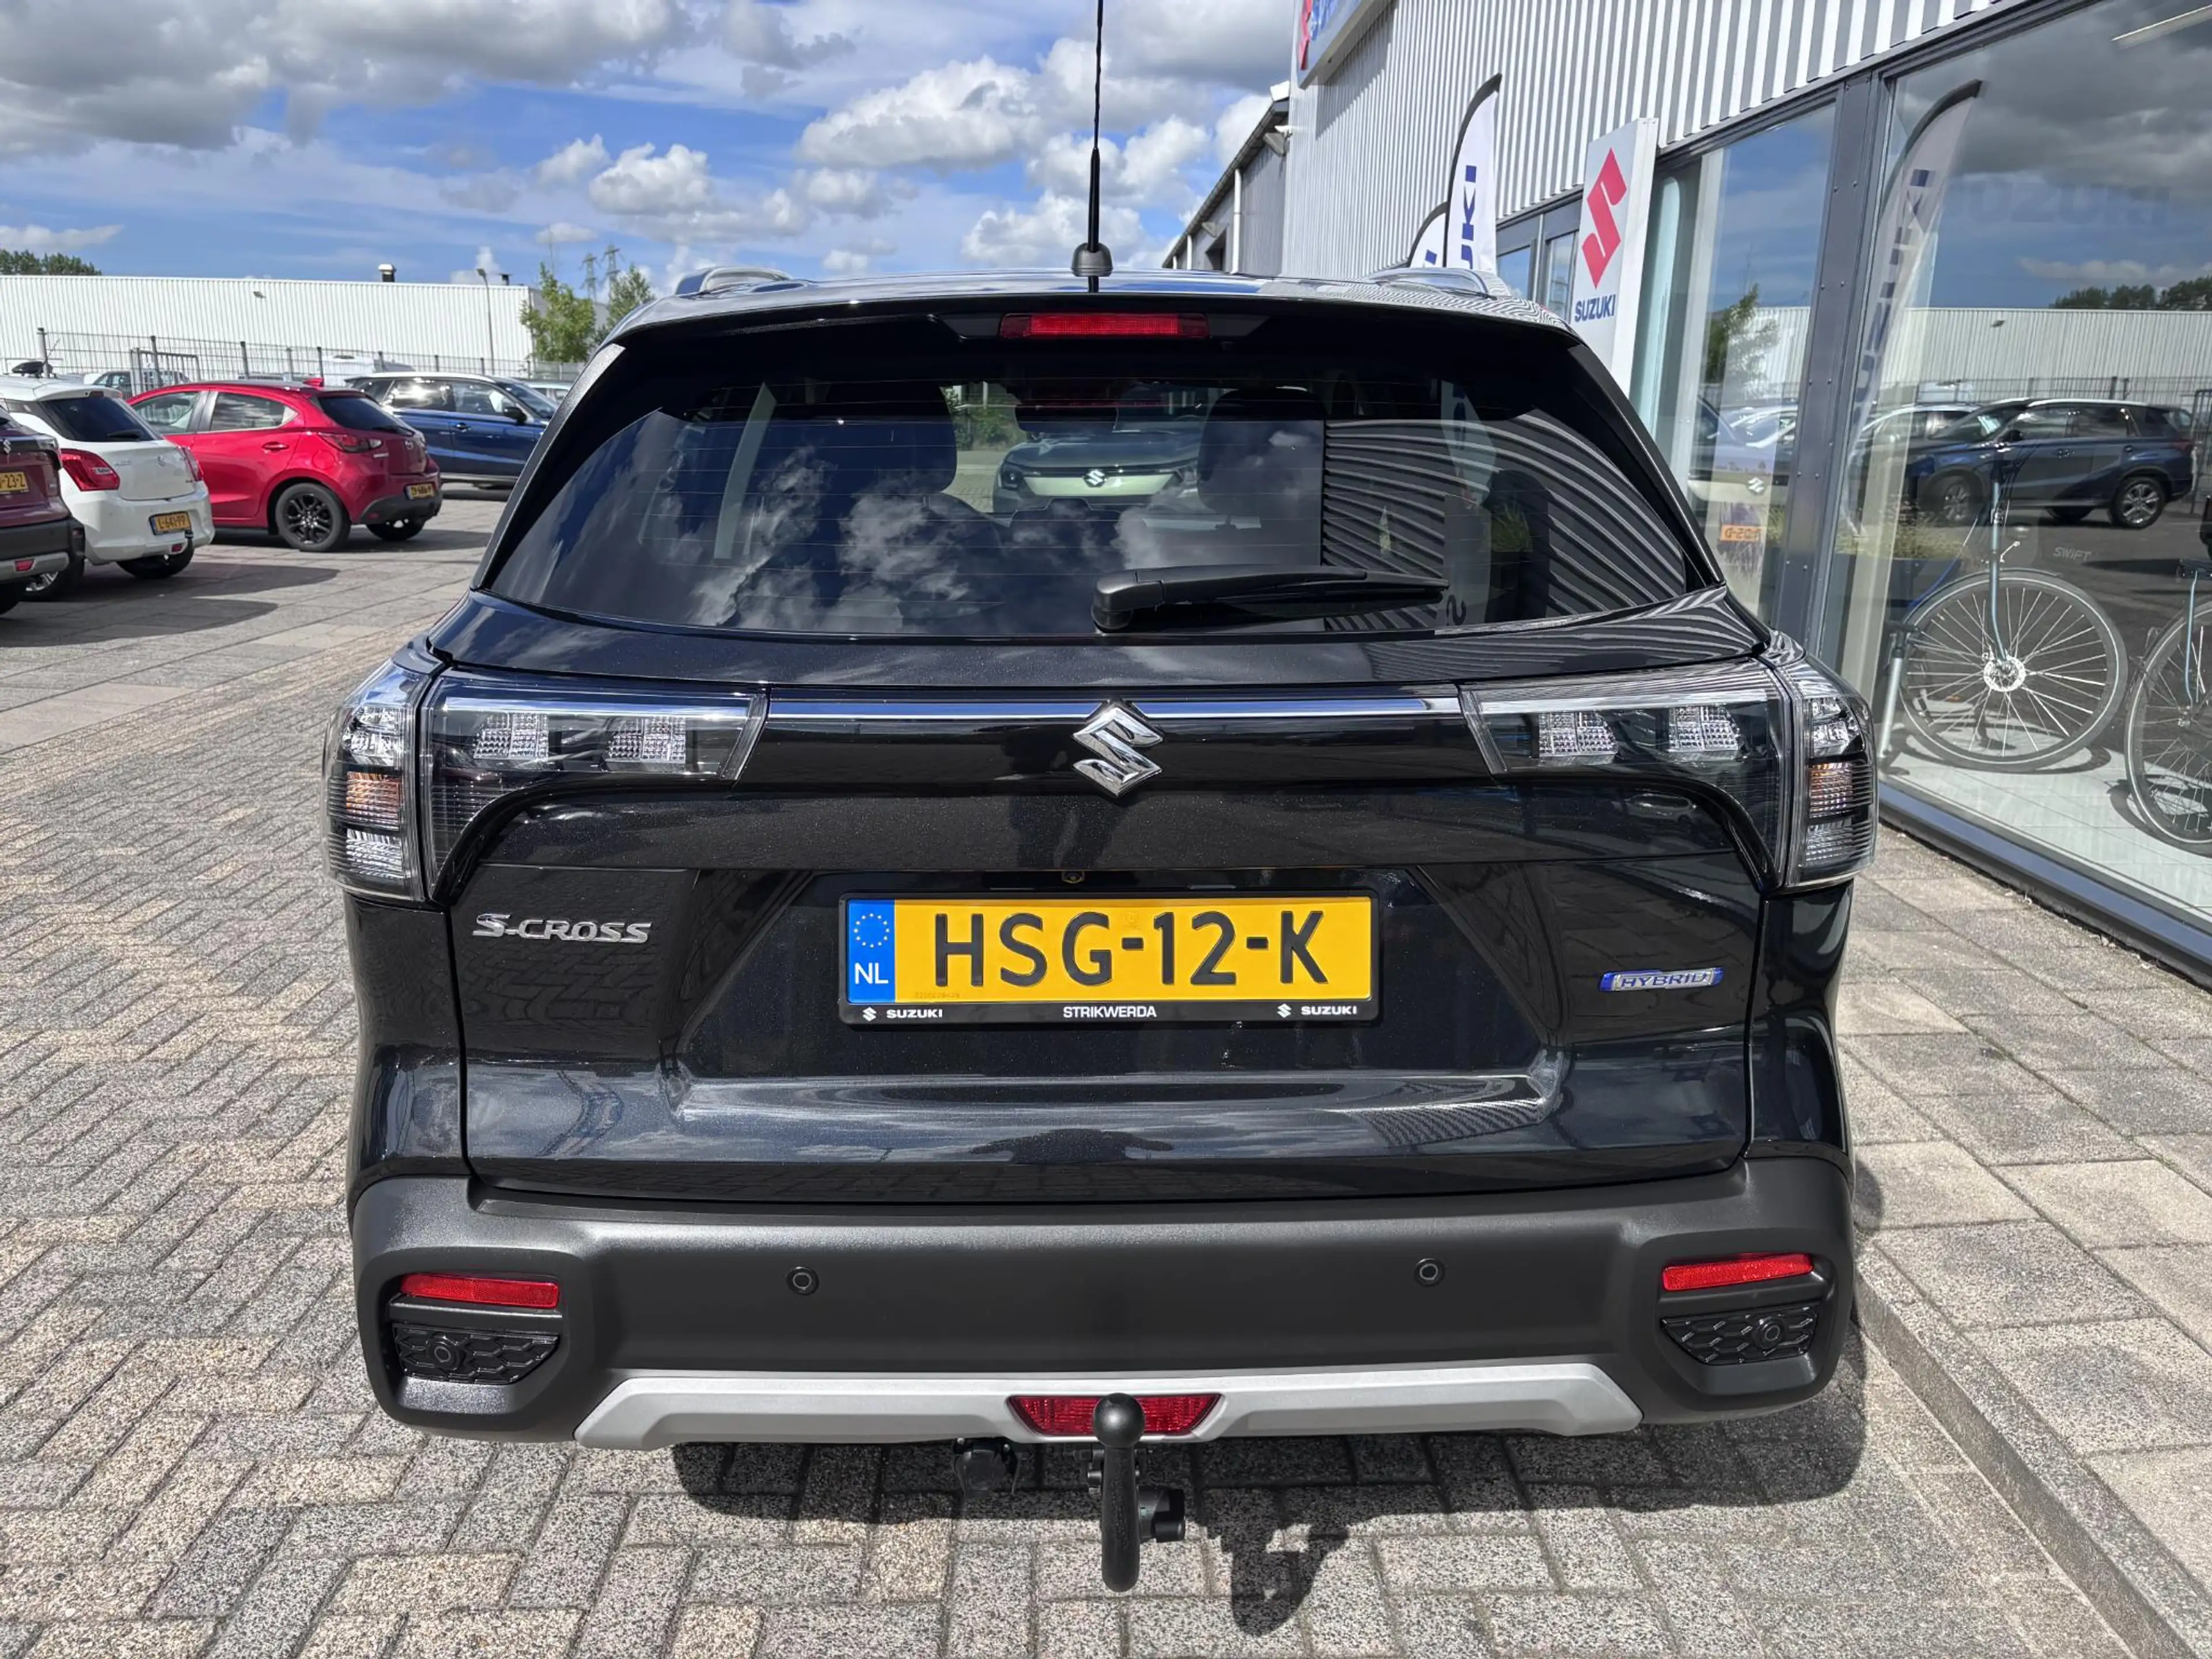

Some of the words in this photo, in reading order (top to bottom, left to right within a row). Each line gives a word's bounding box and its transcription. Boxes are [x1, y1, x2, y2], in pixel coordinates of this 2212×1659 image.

[1574, 294, 1616, 322] SUZUKI
[2052, 546, 2092, 562] SWIFT
[472, 913, 653, 944] S-CROSS
[935, 911, 1330, 987] HSG-12-K
[854, 962, 889, 985] NL
[1620, 972, 1708, 988] HYBRID
[886, 1008, 943, 1019] SUZUKI
[1062, 1005, 1157, 1018] STRIKWERDA
[1300, 1005, 1358, 1016] SUZUKI
